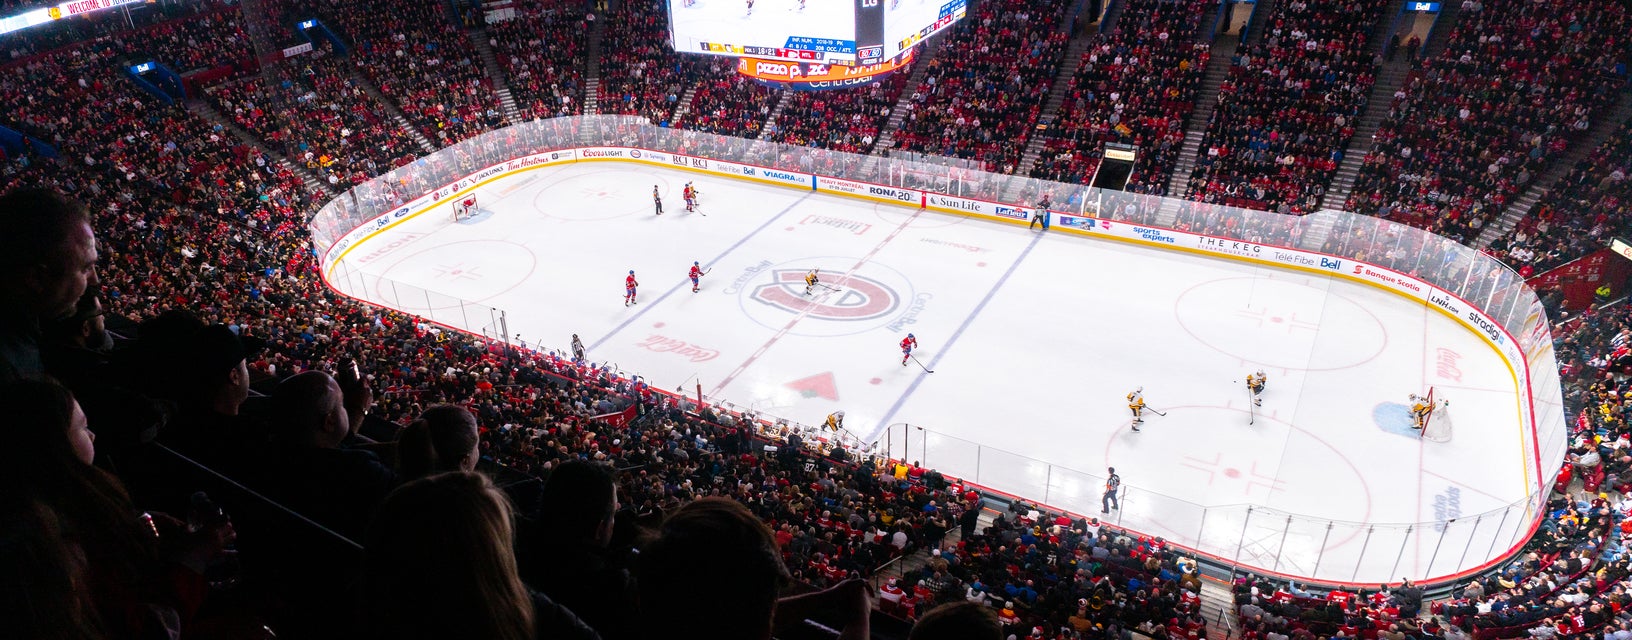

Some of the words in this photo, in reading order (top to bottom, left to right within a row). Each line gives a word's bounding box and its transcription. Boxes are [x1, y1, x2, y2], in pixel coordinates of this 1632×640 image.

[67, 0, 100, 14] WELCOME
[1415, 2, 1430, 10] Bell
[758, 48, 776, 56] 18:21
[137, 63, 149, 72] Bell
[756, 61, 788, 76] pizza
[582, 149, 604, 157] Coors
[506, 161, 520, 171] Tim
[520, 157, 549, 168] Hortons
[673, 155, 687, 163] RCI
[692, 158, 708, 166] RCI
[743, 166, 755, 175] Bell
[870, 187, 897, 197] RONA
[898, 192, 910, 201] 20
[940, 197, 959, 208] Sun
[962, 201, 981, 211] Life
[998, 208, 1026, 218] Lafleur
[377, 216, 389, 227] Bell
[1133, 226, 1161, 236] sports
[1142, 233, 1174, 243] experts
[1199, 237, 1224, 247] THE
[1233, 242, 1260, 253] KEG
[1274, 251, 1293, 262] Télé
[1294, 255, 1315, 266] Fibe
[1320, 258, 1341, 270] Bell
[1365, 269, 1396, 286] Banque
[1397, 279, 1420, 292] Scotia
[1468, 312, 1500, 340] stradigi
[805, 463, 815, 472] 87
